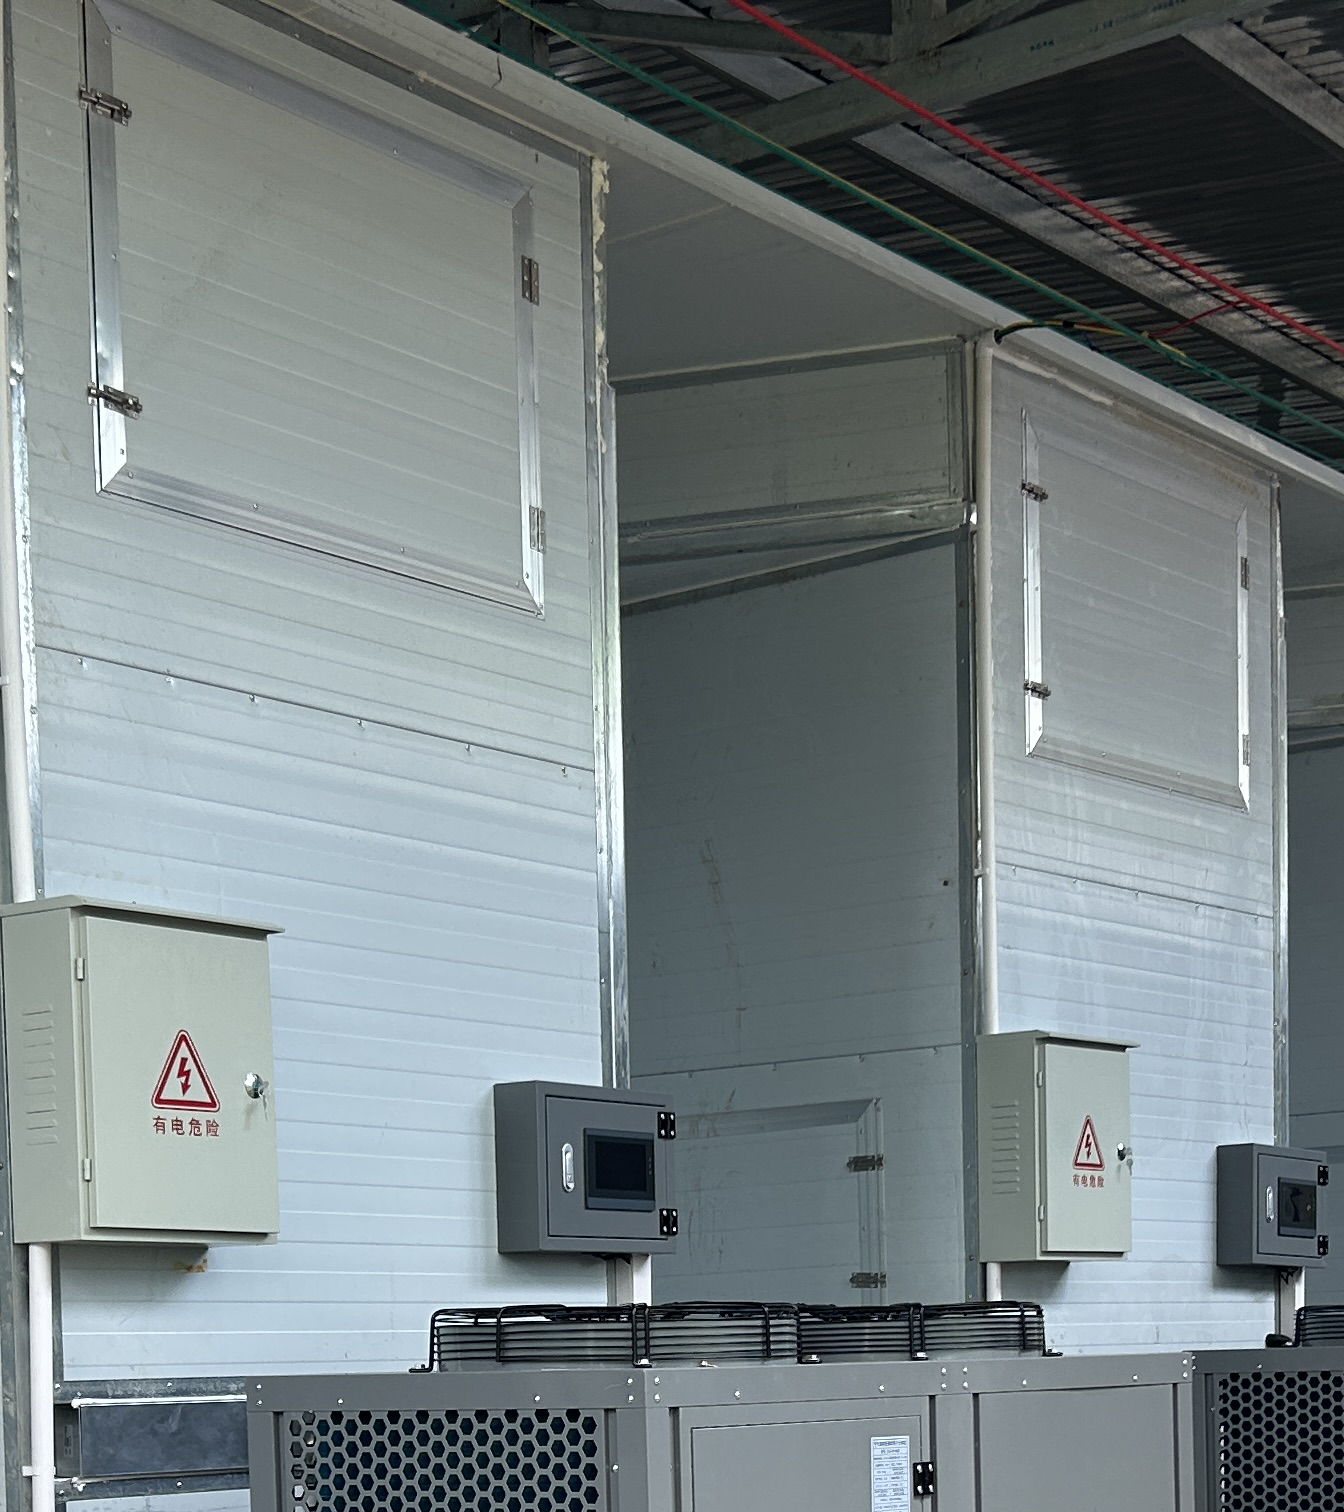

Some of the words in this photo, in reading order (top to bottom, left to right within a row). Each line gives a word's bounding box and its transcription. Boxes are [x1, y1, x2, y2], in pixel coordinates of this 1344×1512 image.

[152, 1116, 221, 1137] 有电危险
[1072, 1173, 1105, 1188] 有电危险
